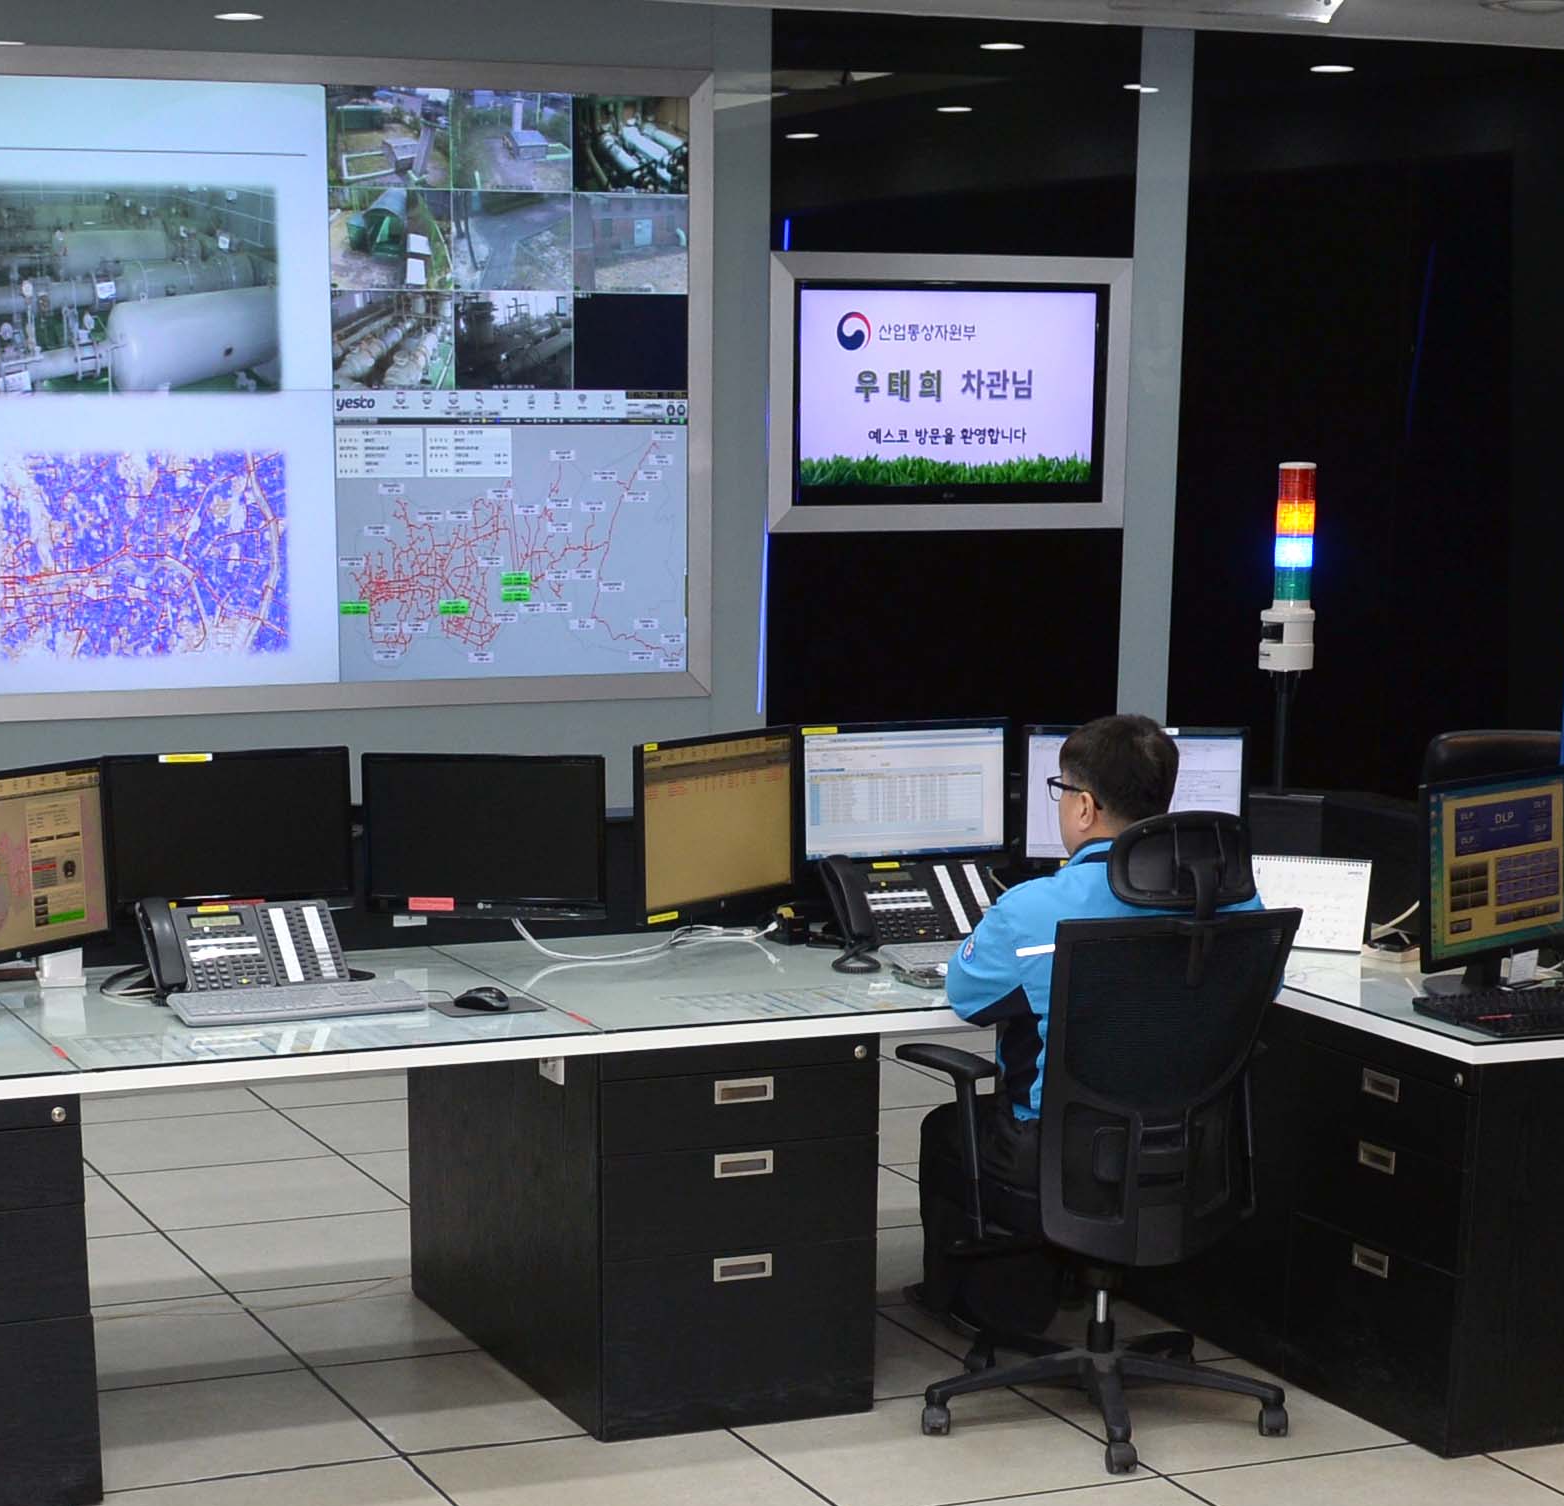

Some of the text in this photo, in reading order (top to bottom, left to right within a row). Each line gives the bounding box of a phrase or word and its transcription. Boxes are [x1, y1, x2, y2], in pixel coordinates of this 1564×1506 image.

[878, 323, 977, 342] 산업통상자원부
[855, 368, 1034, 403] 우태희 차관님
[868, 427, 1028, 446] 예스코 방문을 환영합니다
[1494, 811, 1515, 825] DLP
